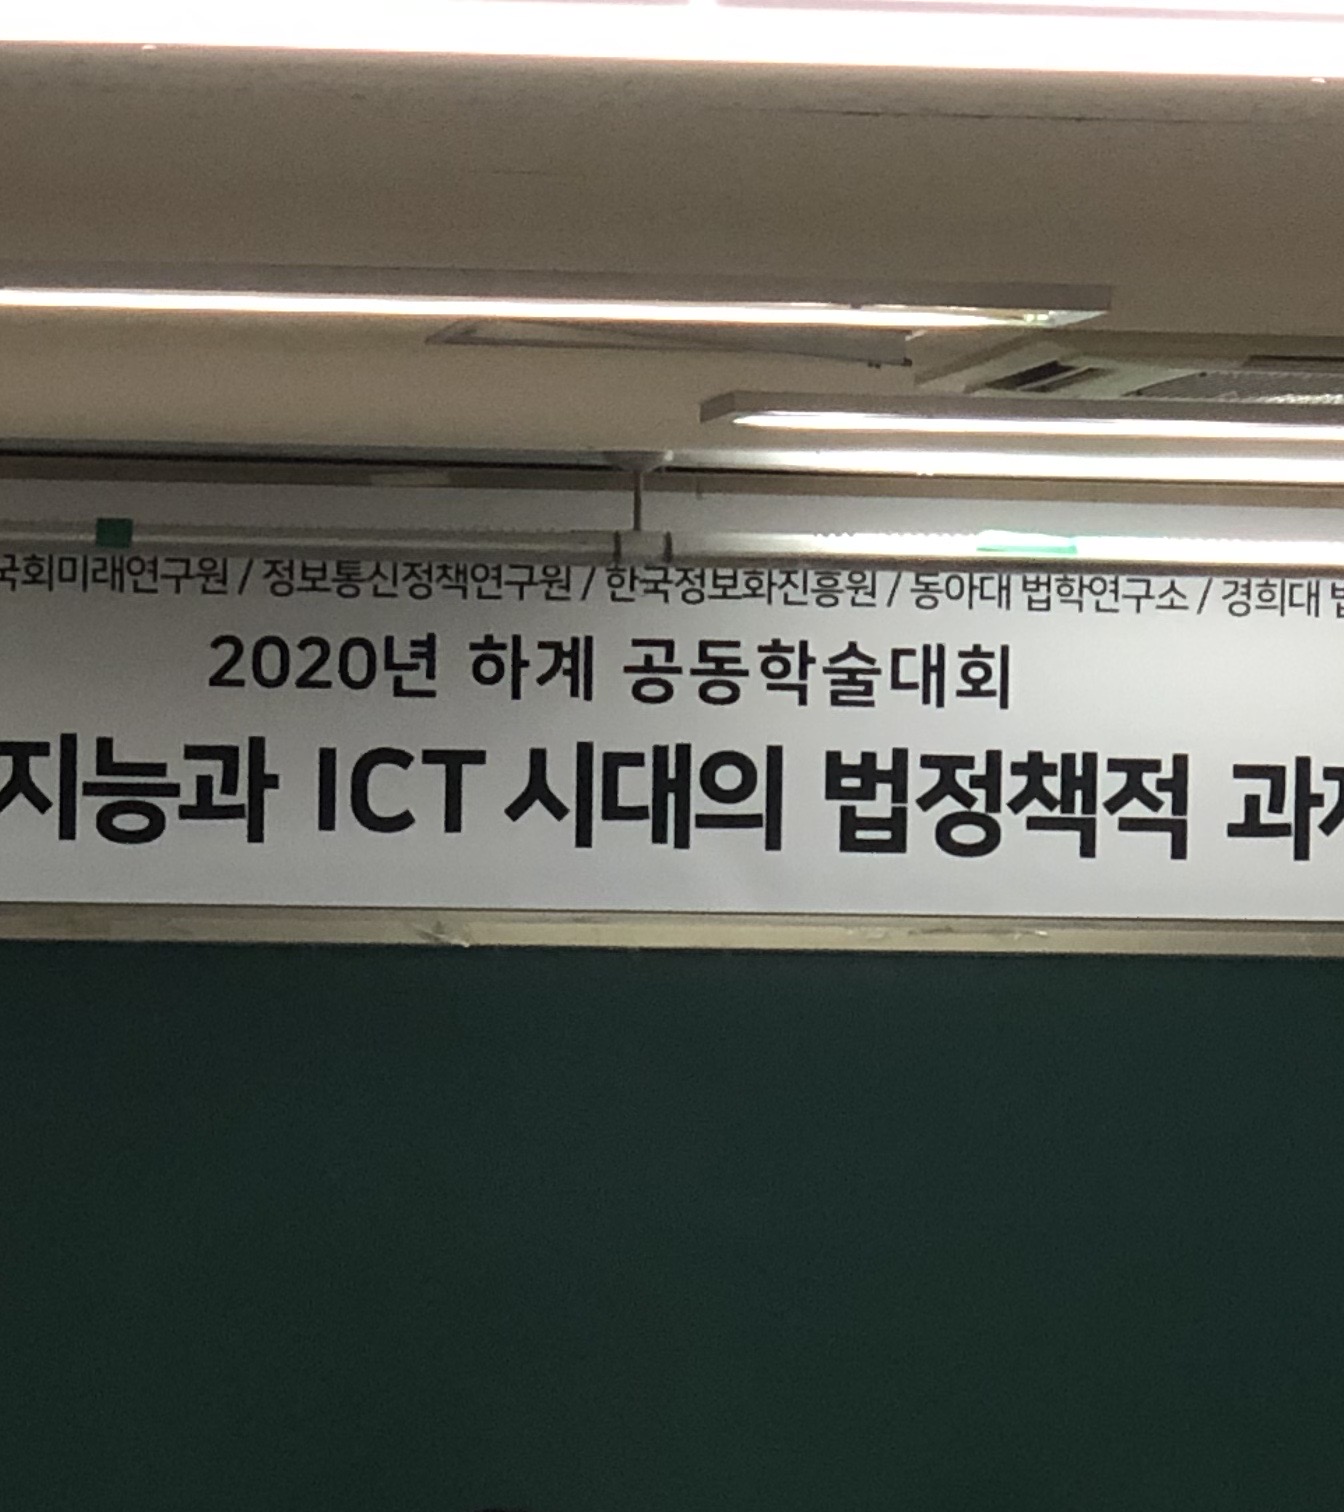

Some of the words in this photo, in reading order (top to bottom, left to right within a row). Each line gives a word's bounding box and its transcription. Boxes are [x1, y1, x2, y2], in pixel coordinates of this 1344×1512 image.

[262, 557, 572, 601] 정보통신정책연구원
[606, 565, 877, 608] 한국정보화진흥원
[911, 571, 1011, 612] 동아대
[1021, 573, 1189, 615] 법학연구소
[1221, 577, 1320, 618] 경희대
[208, 632, 438, 699] 2020년
[468, 633, 594, 702] 하계
[623, 637, 1010, 710] 공동학술대회
[316, 745, 487, 836] ICT
[503, 739, 784, 852] 시대의
[823, 746, 1189, 862] 법정책적
